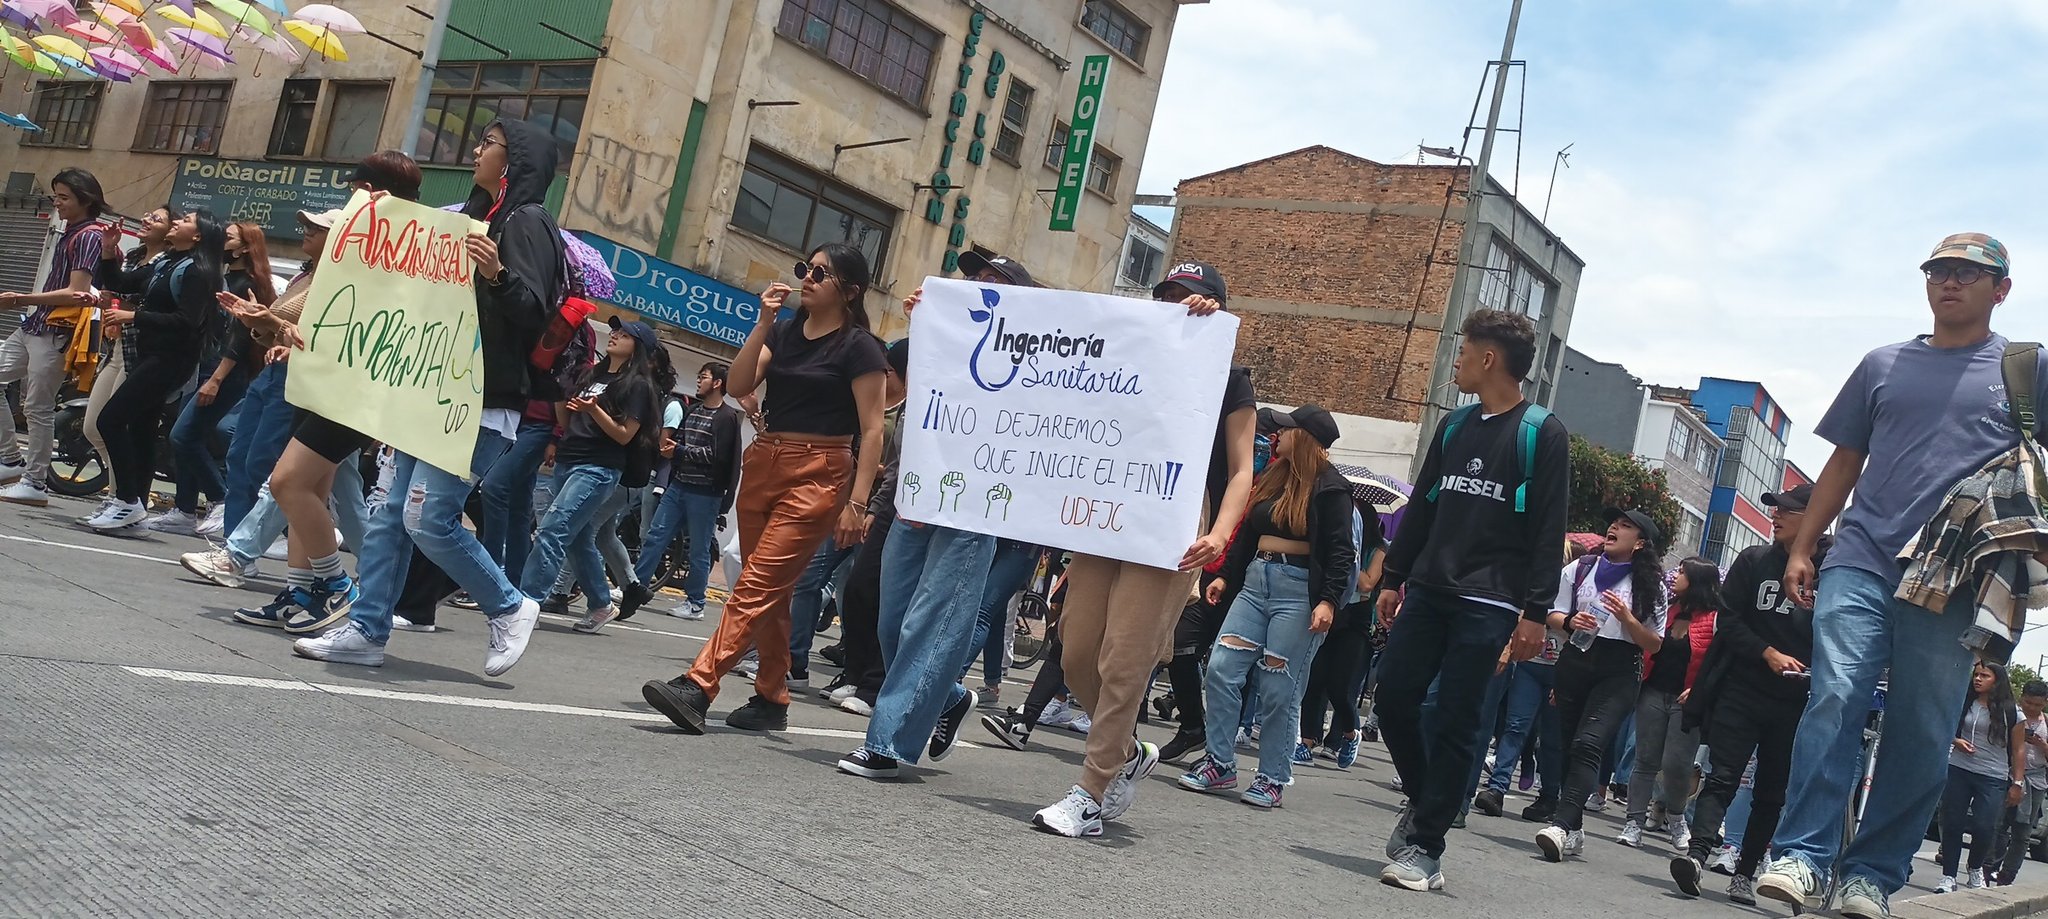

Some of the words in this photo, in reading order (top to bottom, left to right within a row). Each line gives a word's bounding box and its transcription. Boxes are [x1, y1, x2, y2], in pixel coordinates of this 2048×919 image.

[985, 50, 1006, 98] DE
[967, 113, 986, 166] LA
[1056, 61, 1103, 222] HOTEL
[218, 184, 245, 196] CORTE
[248, 187, 253, 197] Y
[255, 188, 297, 201] GRABADO
[1168, 263, 1203, 278] NASA
[613, 289, 682, 326] SABANA
[993, 317, 1105, 365] Ingeniería
[1021, 355, 1143, 395] Sanitaria
[444, 403, 469, 434] UD
[995, 409, 1123, 447] DEJAREMOS
[973, 443, 1017, 475] QUE
[1025, 451, 1088, 480] INICIE
[1093, 458, 1116, 485] EL
[1123, 461, 1183, 501] FIN!!
[1060, 495, 1124, 533] UDFJC
